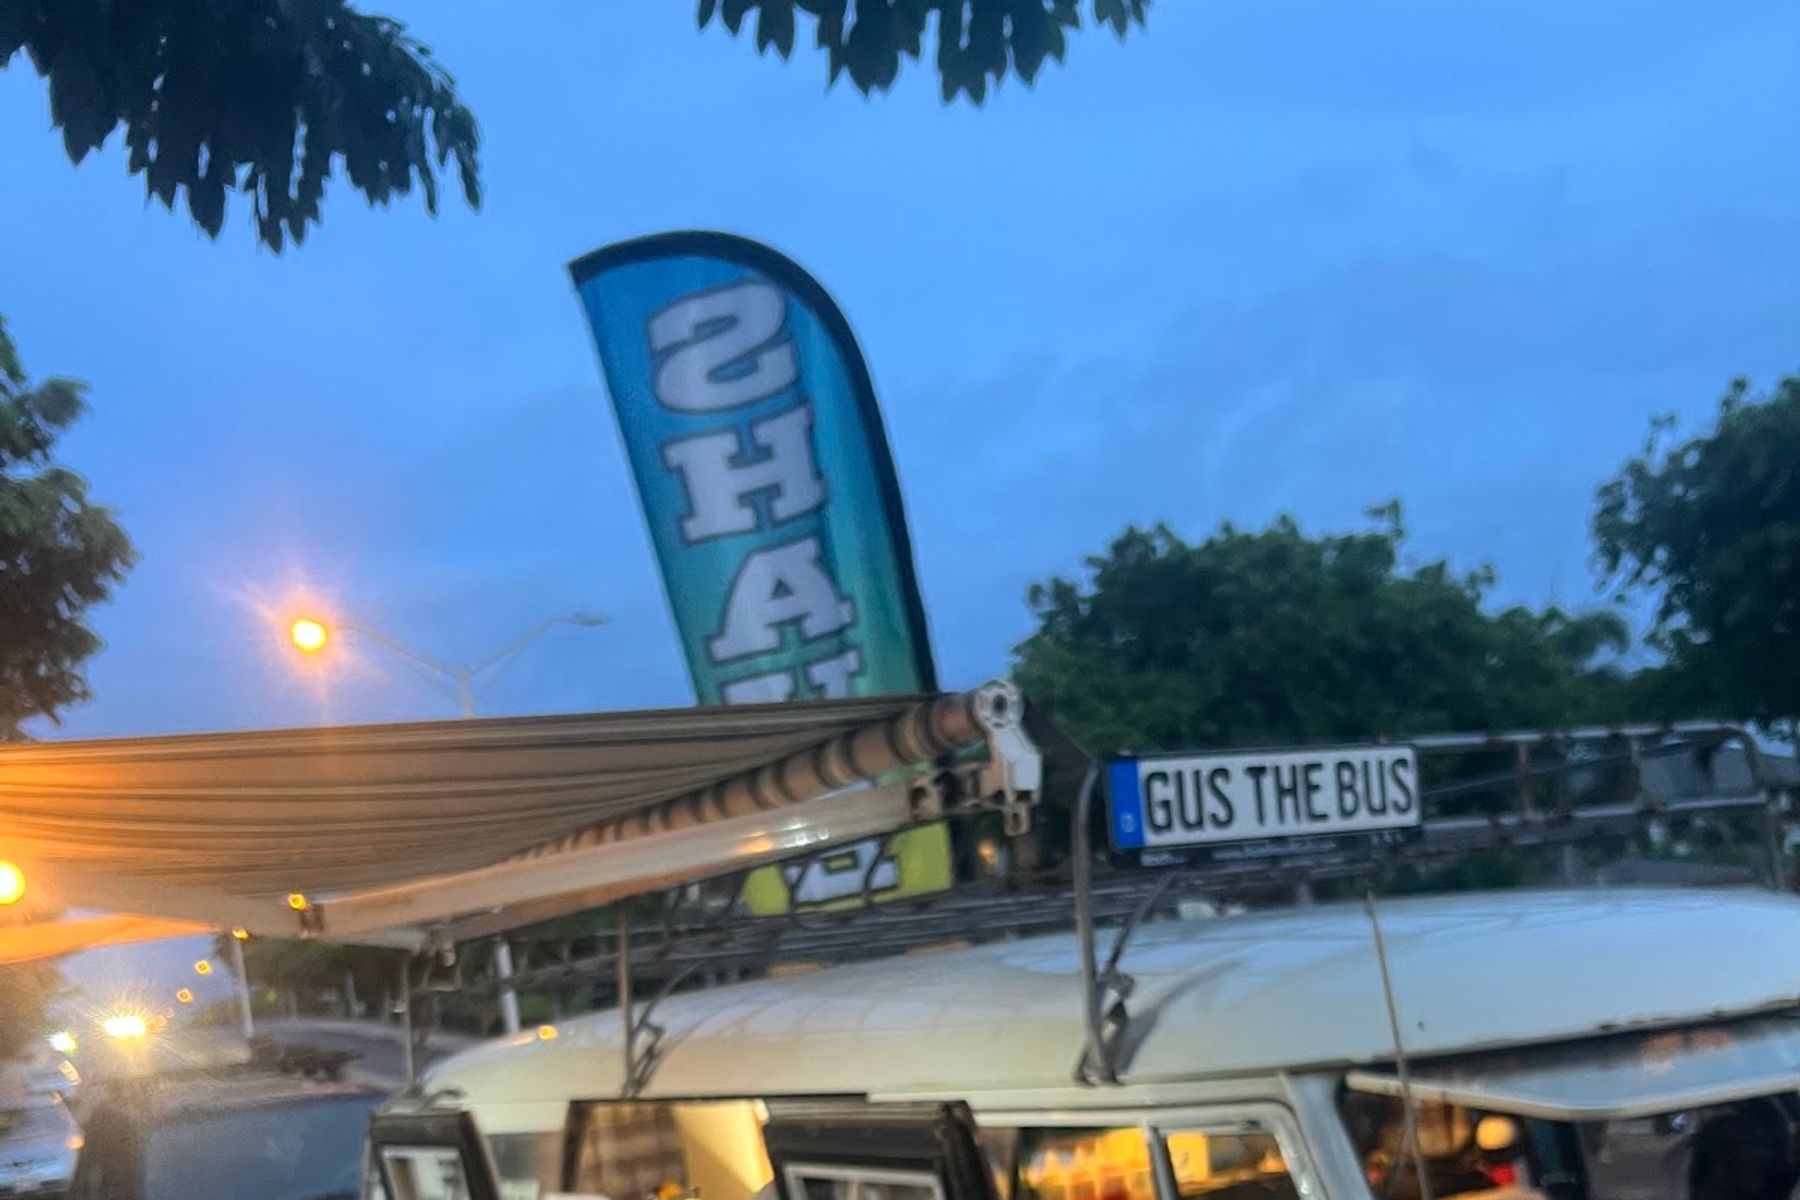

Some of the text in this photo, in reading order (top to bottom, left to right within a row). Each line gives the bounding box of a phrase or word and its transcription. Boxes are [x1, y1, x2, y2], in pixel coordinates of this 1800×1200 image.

[1145, 757, 1413, 835] GUS THE BUS
